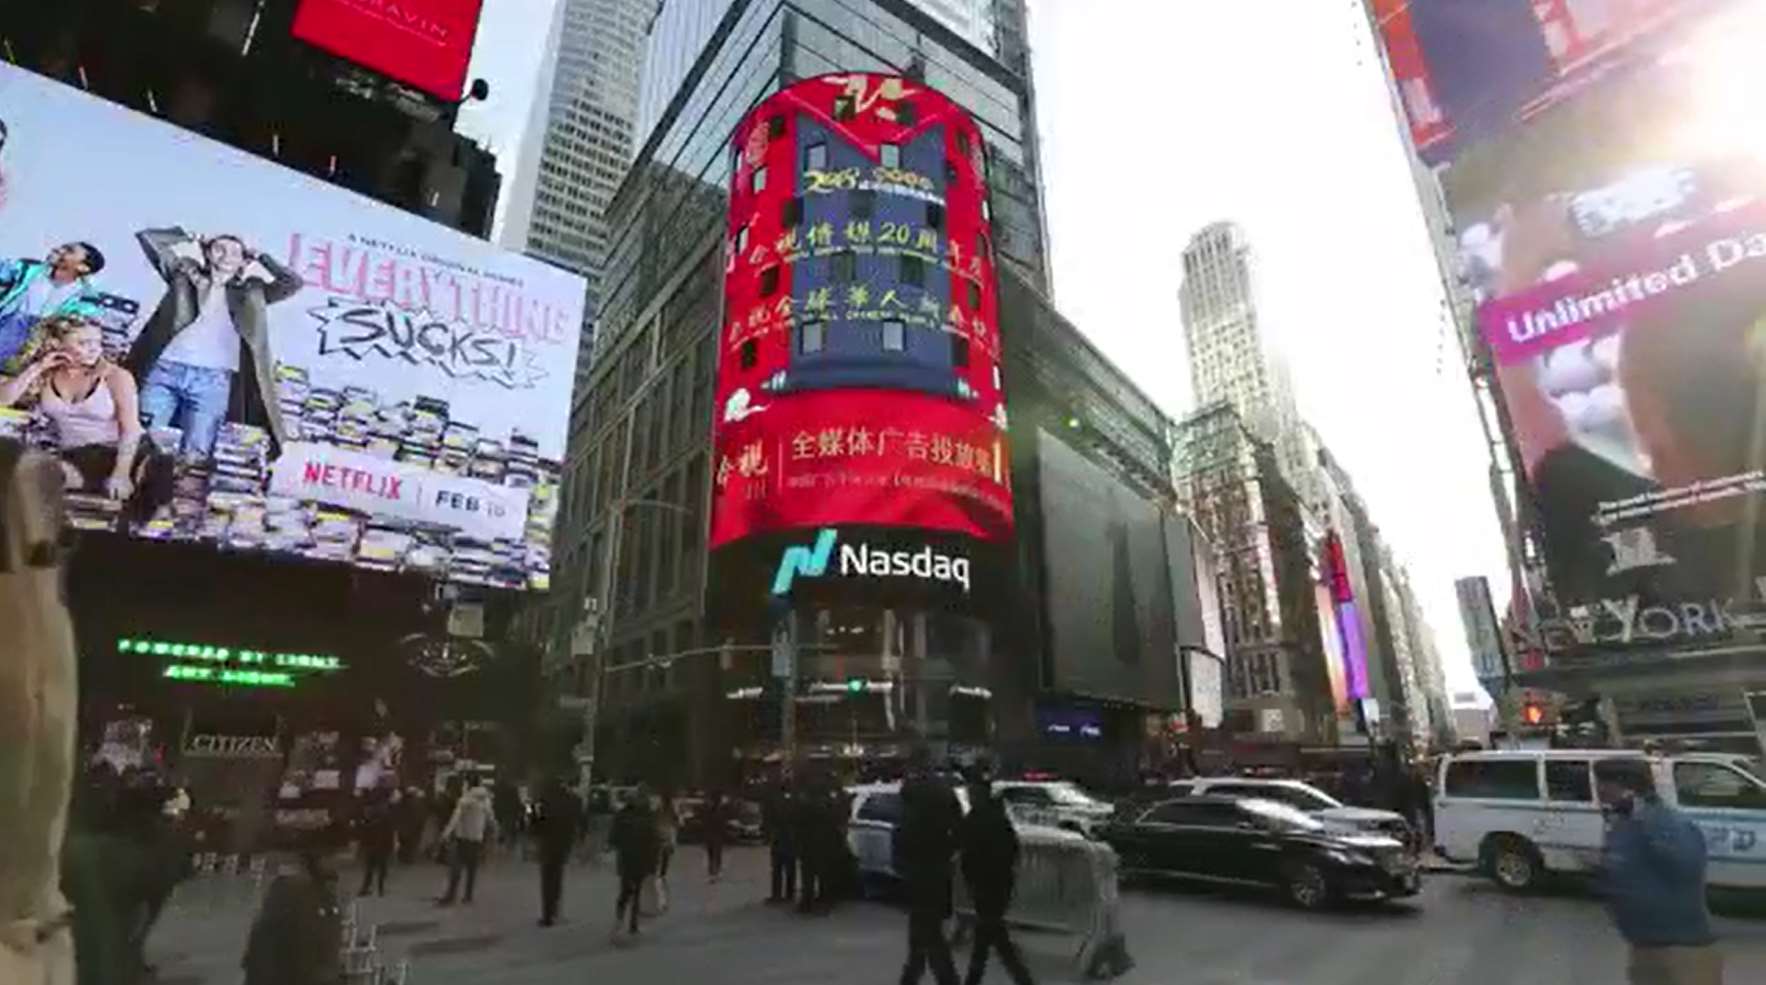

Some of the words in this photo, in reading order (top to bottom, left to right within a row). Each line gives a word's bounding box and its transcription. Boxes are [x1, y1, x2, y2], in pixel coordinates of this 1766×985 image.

[290, 232, 568, 344] EVERYTHING
[1507, 253, 1698, 343] Unlimited
[339, 307, 517, 380] SUCKS!
[304, 461, 402, 500] NETFLIX
[435, 489, 480, 512] FEB
[841, 543, 971, 593] Nasdaq
[192, 733, 277, 753] CITIZEN
